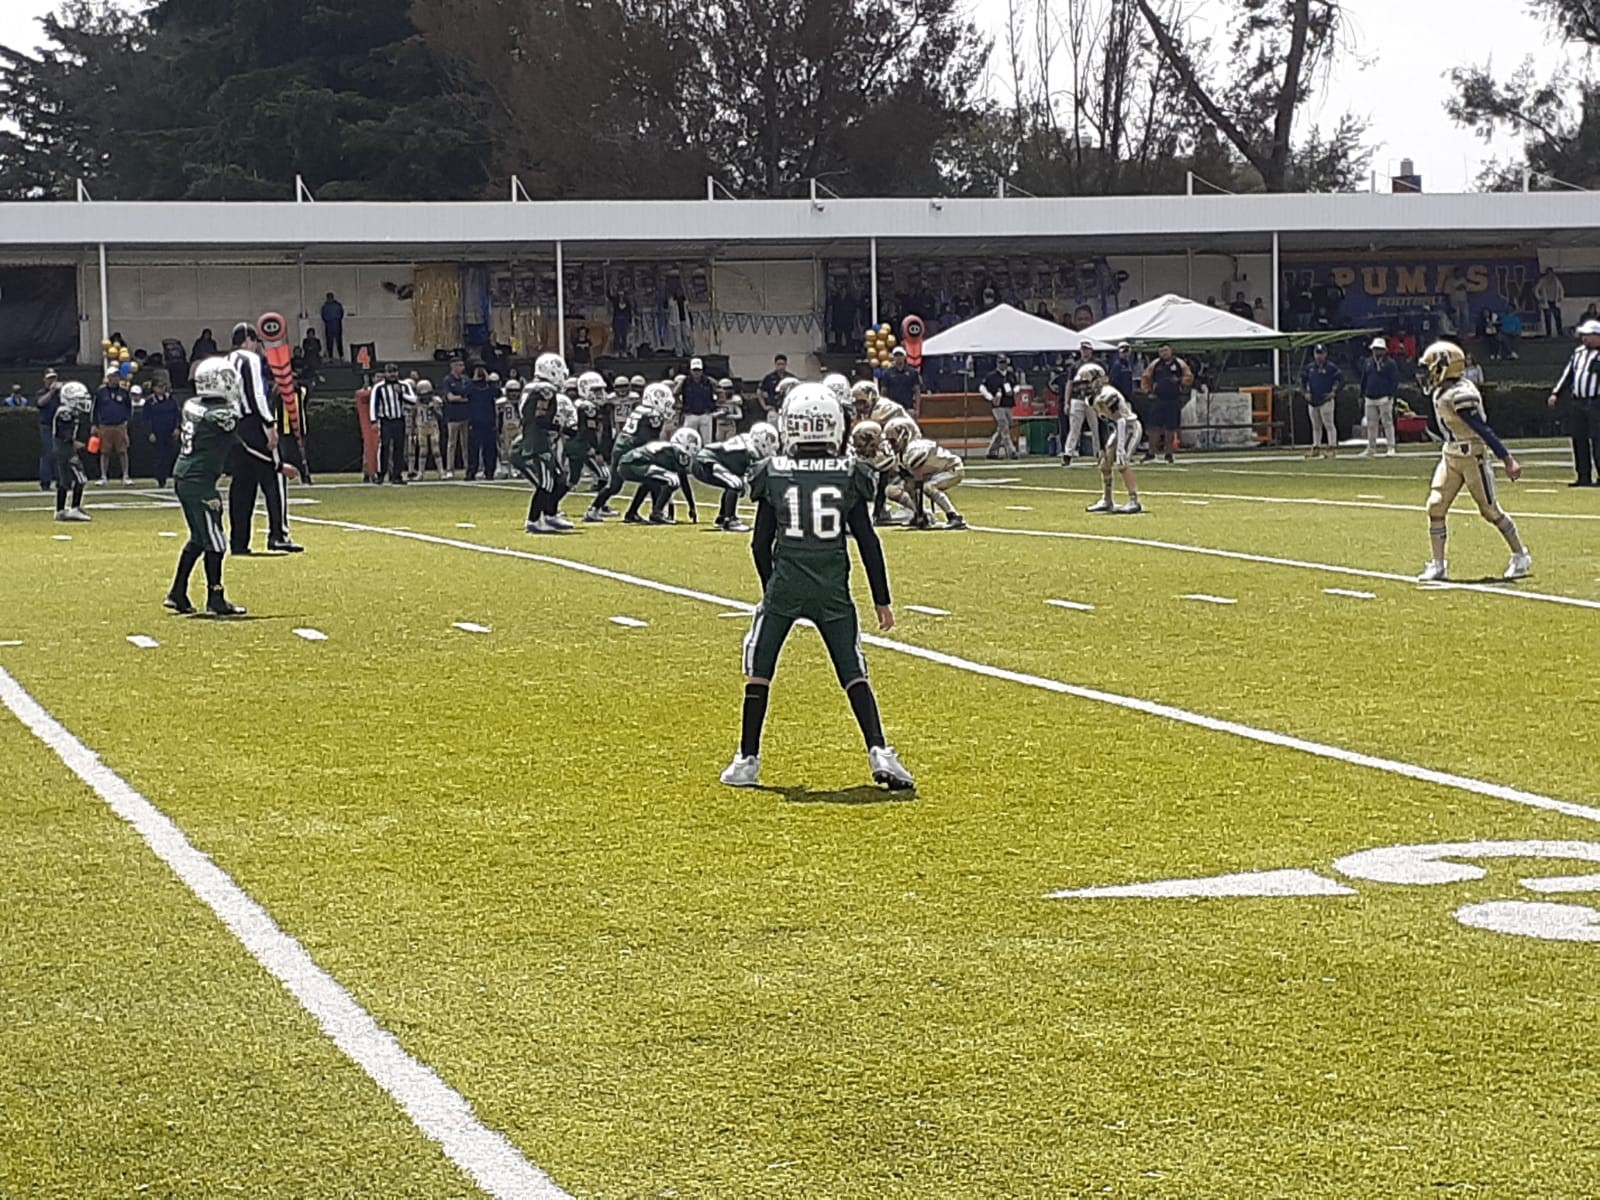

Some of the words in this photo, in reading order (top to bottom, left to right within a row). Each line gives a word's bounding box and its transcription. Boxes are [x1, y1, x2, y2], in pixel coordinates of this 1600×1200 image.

[357, 346, 370, 369] 4
[772, 457, 849, 471] UAEMEX
[784, 486, 842, 539] 16
